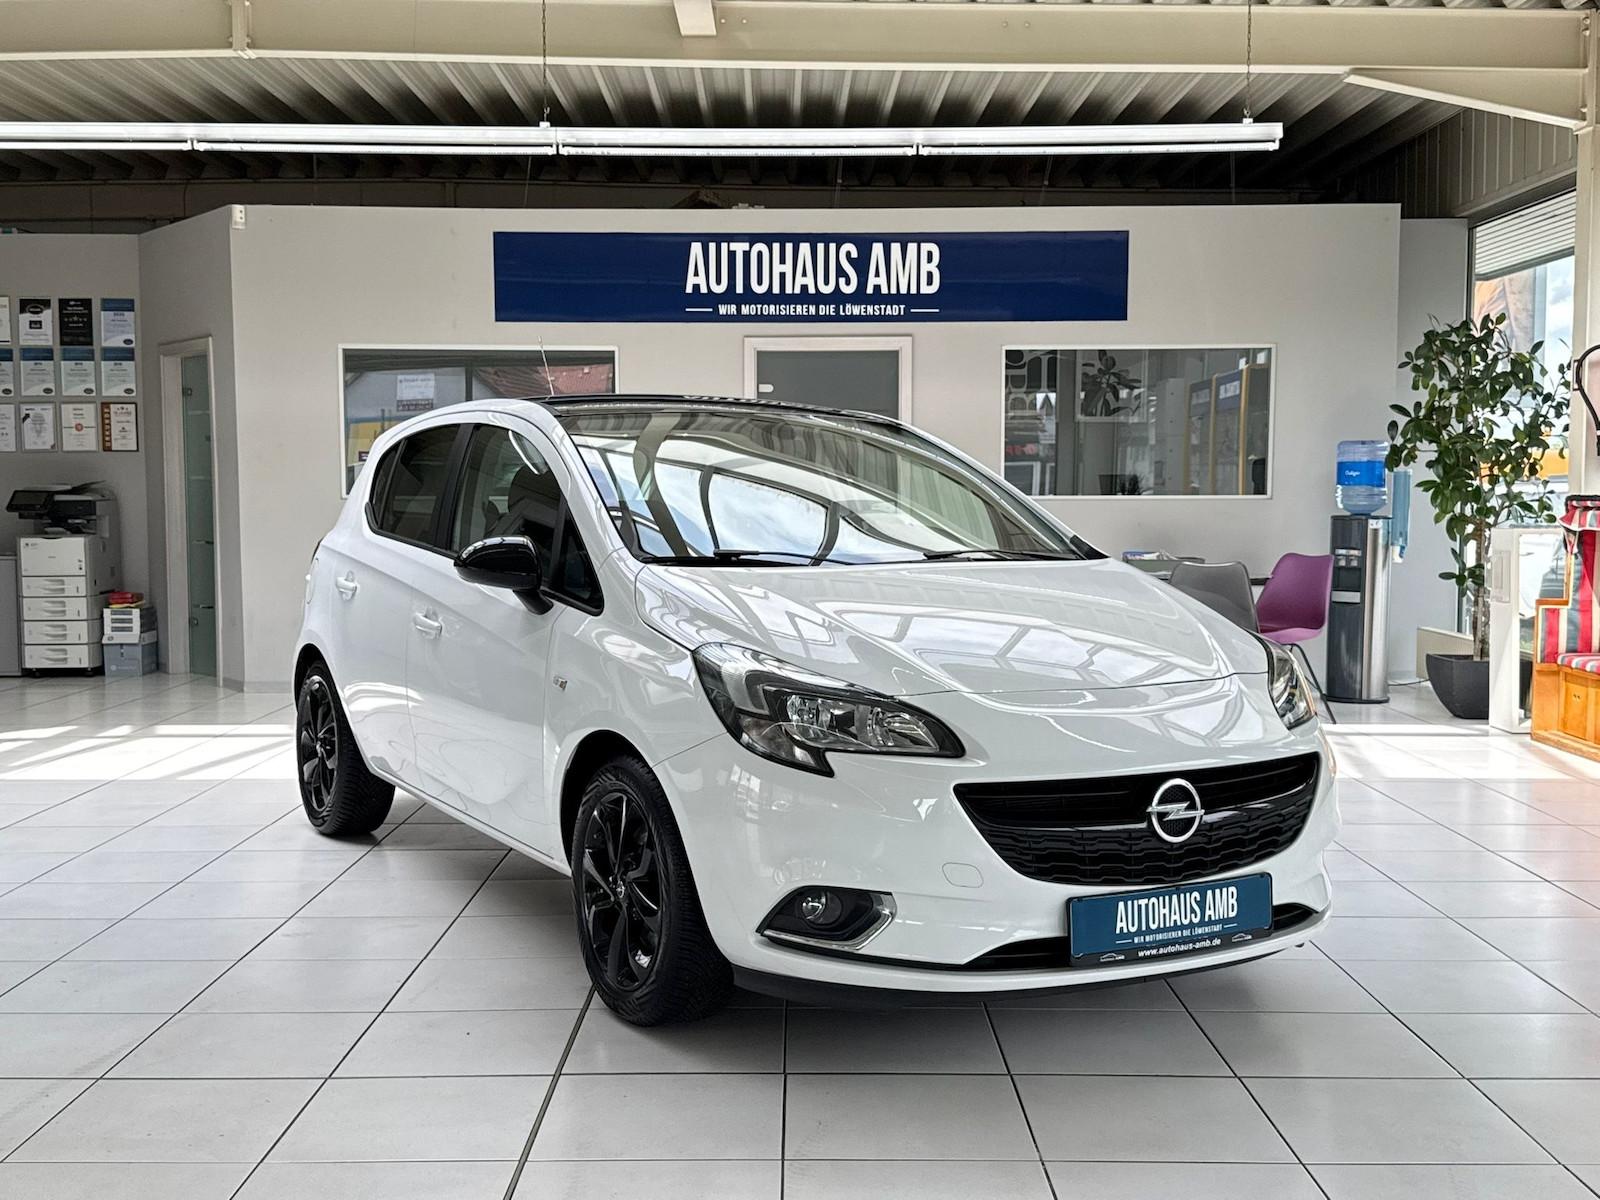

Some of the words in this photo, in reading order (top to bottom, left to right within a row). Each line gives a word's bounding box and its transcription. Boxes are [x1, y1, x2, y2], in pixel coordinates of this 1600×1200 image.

[685, 242, 859, 294] AUTOHAUS
[866, 242, 940, 294] AMB
[718, 304, 737, 315] WIR
[741, 304, 816, 315] MOTORISIEREN
[819, 304, 836, 315] DIE
[840, 303, 906, 315] LÖWENSTADT
[1115, 891, 1201, 934] AUTOHAUS
[1204, 886, 1238, 922] AMB
[1133, 935, 1145, 944] WIR
[1145, 930, 1182, 943] MOTORISIEREN
[1182, 928, 1191, 937] DIE
[1192, 923, 1223, 936] LÖWENSTADT
[1138, 937, 1222, 957] www.autohaus-amb.de
